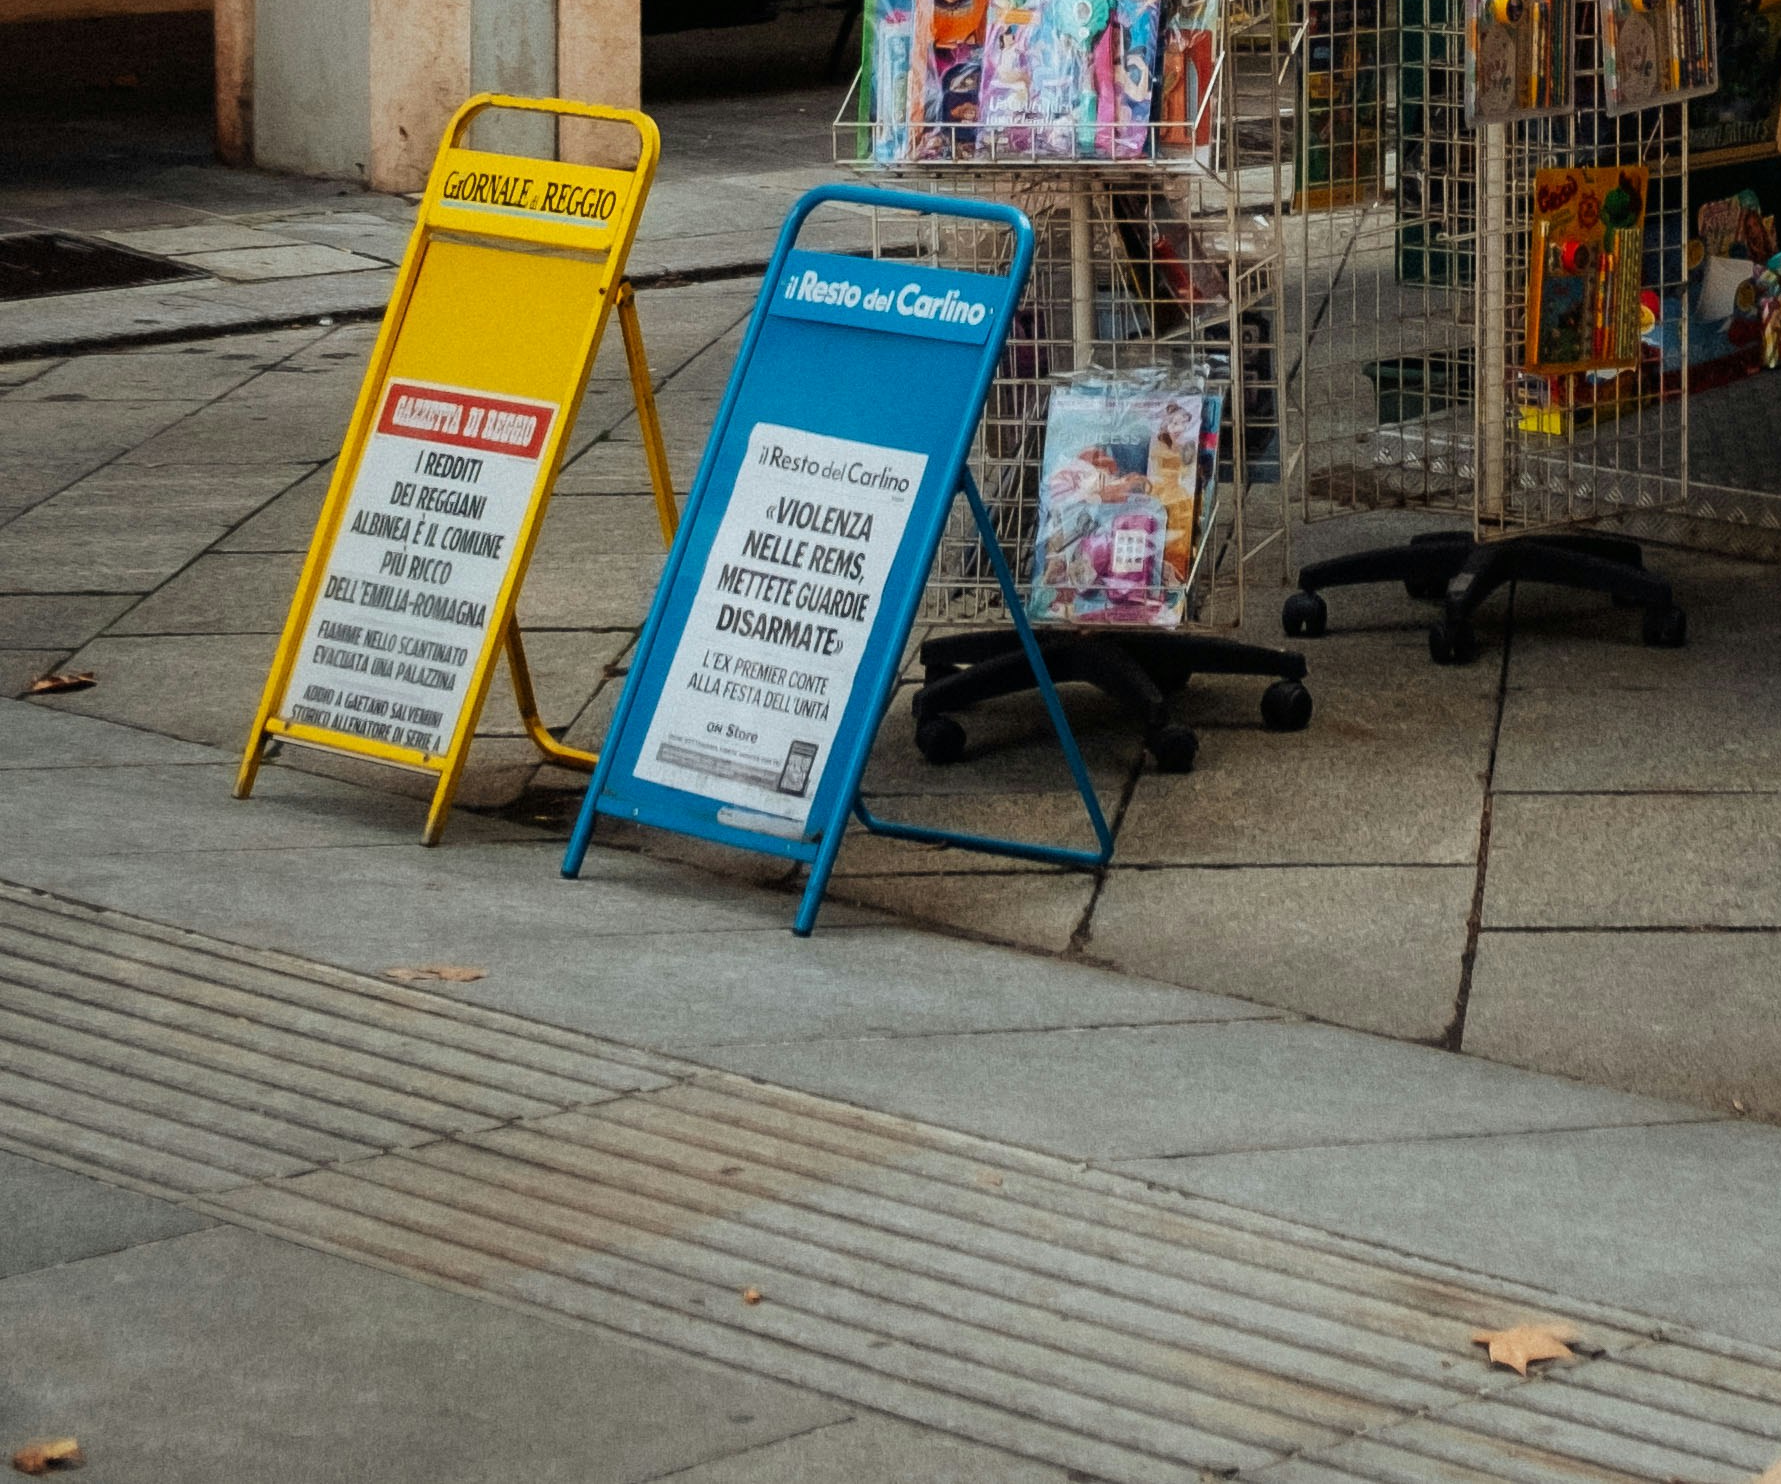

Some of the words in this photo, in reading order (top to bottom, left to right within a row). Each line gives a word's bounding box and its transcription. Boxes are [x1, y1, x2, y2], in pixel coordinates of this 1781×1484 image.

[541, 181, 617, 220] REGGIO
[785, 274, 798, 300] il
[797, 269, 862, 308] Resto
[862, 286, 896, 313] del
[896, 282, 986, 326] Carlino
[392, 395, 463, 435] GAZZETTA
[462, 406, 485, 439] DI
[481, 408, 538, 448] REGGIO
[414, 448, 425, 474] I
[423, 451, 483, 484] REDDITI
[758, 445, 769, 465] il
[768, 445, 820, 476] Resto
[821, 460, 847, 481] del
[847, 462, 910, 494] Carlino
[390, 480, 417, 509] DEI
[415, 485, 488, 521] REGGIANI
[766, 496, 874, 543] «VIOLENZA
[351, 509, 412, 543] ALBINEA
[412, 512, 426, 544] È
[422, 520, 440, 548] IL
[440, 525, 506, 560] COMUNE
[741, 529, 809, 569] NELLE
[808, 544, 866, 585] REMS,
[379, 545, 408, 578] PIÙ
[407, 551, 453, 585] RICCO
[323, 574, 488, 629] DELL'EMILIA-ROMAGNA
[716, 563, 799, 607] METTETE
[795, 582, 871, 623] GUARDIE
[317, 619, 364, 646] FIAMME
[363, 629, 398, 653] NELLO
[398, 635, 469, 668] SCANTINATO
[715, 603, 845, 657] DISARMATE»
[312, 644, 371, 674] EVACUATA
[370, 656, 395, 679] UNA
[395, 661, 457, 692] PALAZZINA
[701, 648, 734, 675] L'EX
[732, 657, 789, 688] PREMIER
[787, 669, 830, 696] CONTE
[344, 692, 389, 717] GAETANO
[389, 700, 444, 729] SALVEMINI
[687, 672, 722, 696] ALLA
[722, 680, 762, 708] FESTA
[762, 689, 831, 722] DELL'UNITÀ
[331, 713, 393, 743] ALLENATORE
[391, 725, 405, 744] DI
[401, 728, 434, 750] SERIE
[725, 723, 759, 745] Store
